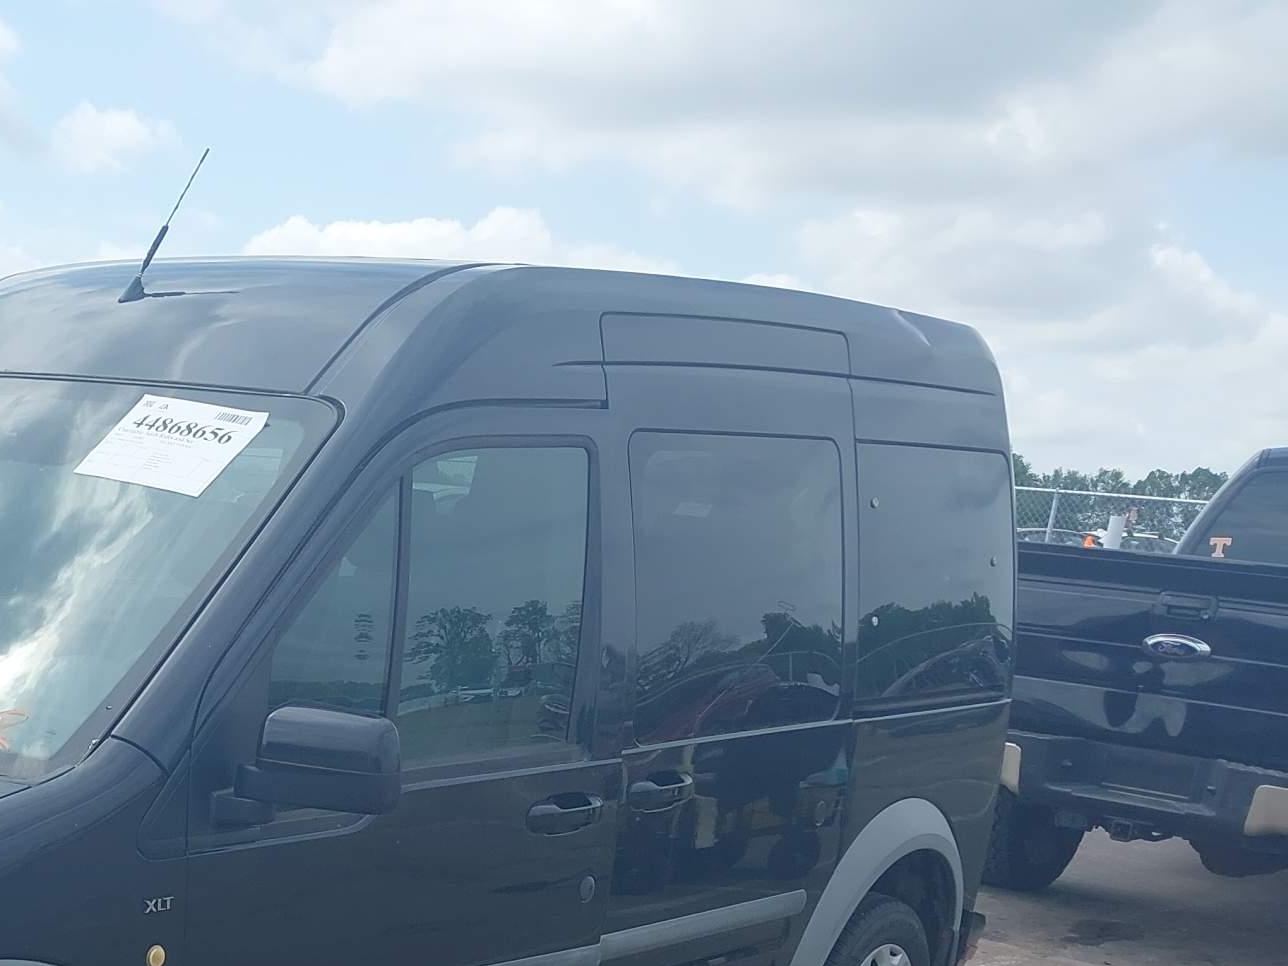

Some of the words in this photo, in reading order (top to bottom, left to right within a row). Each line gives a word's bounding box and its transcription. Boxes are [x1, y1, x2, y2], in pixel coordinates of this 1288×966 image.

[132, 414, 239, 445] 44868656
[1209, 537, 1233, 558] T
[143, 896, 175, 914] XLT
